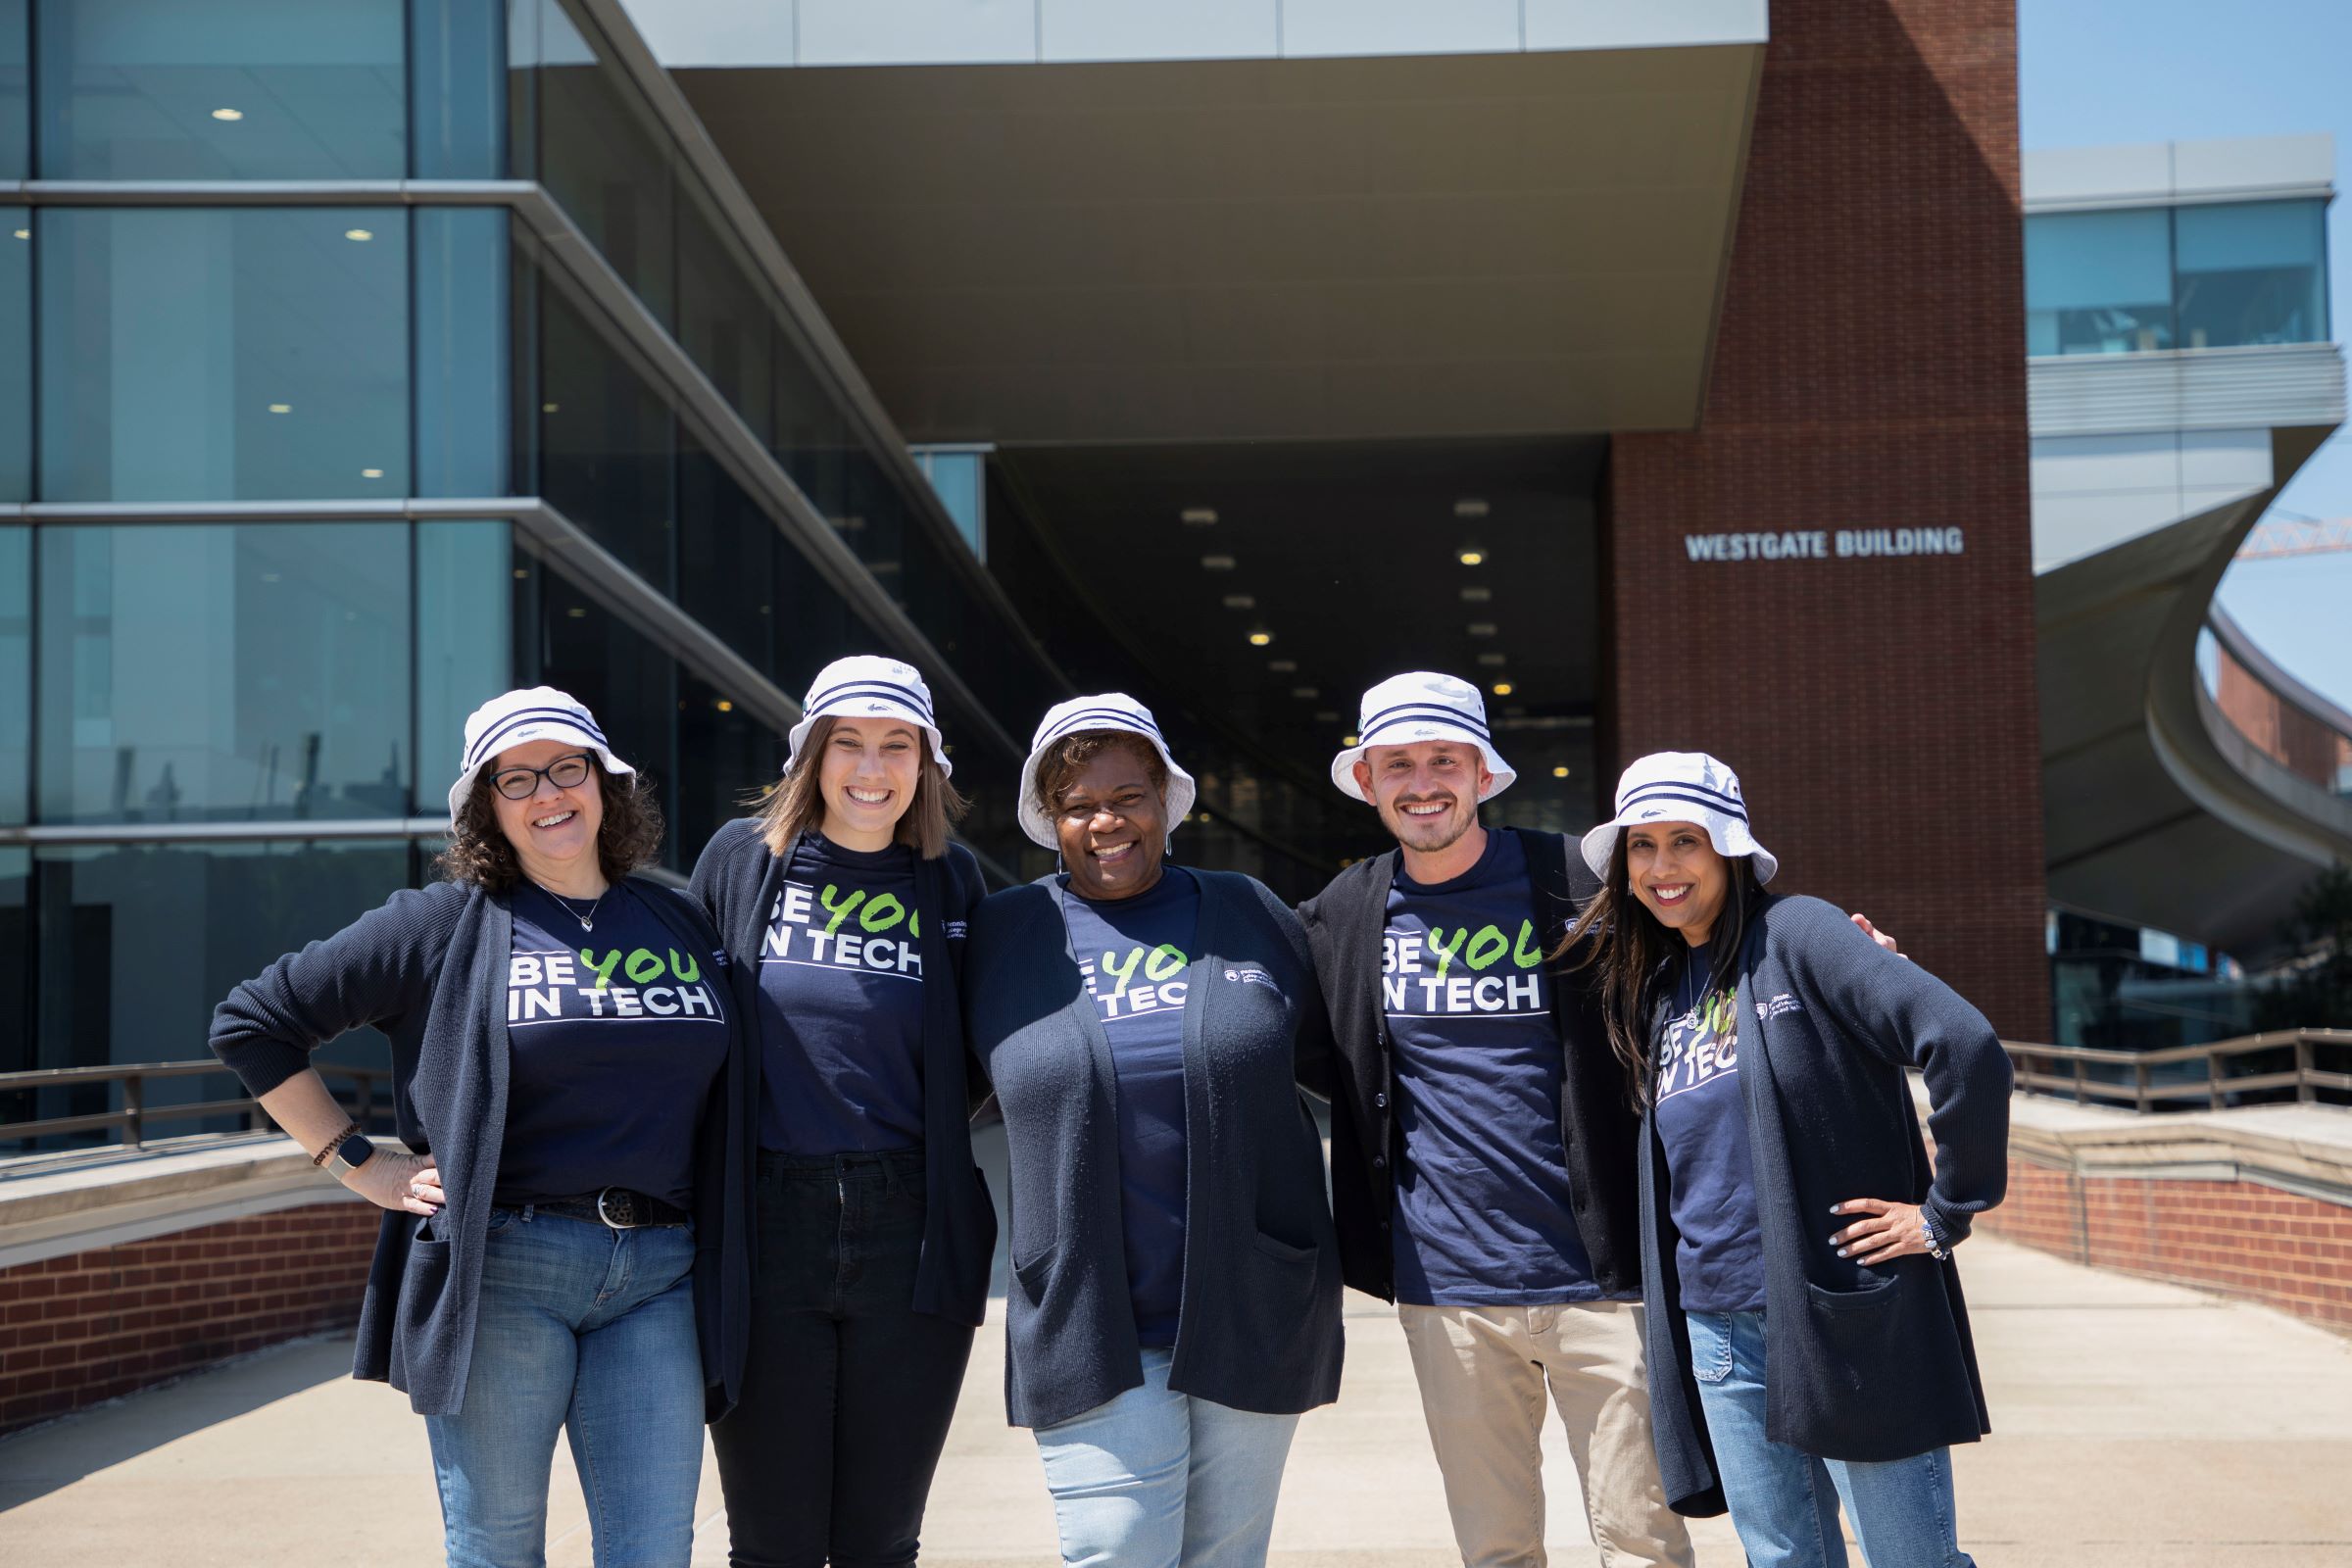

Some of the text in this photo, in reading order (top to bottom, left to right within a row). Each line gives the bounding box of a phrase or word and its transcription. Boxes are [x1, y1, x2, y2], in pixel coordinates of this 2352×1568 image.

[1685, 526, 1963, 561] WESTGATE BUILDING
[509, 956, 577, 988] BE
[580, 948, 701, 991] YOU
[760, 924, 793, 956] N
[807, 928, 923, 976] TECH
[1102, 943, 1188, 998] YO
[508, 986, 715, 1021] IN TECH
[1097, 982, 1189, 1017] TEC
[1382, 973, 1541, 1012] N TECH
[1684, 1035, 1738, 1086] TEC
